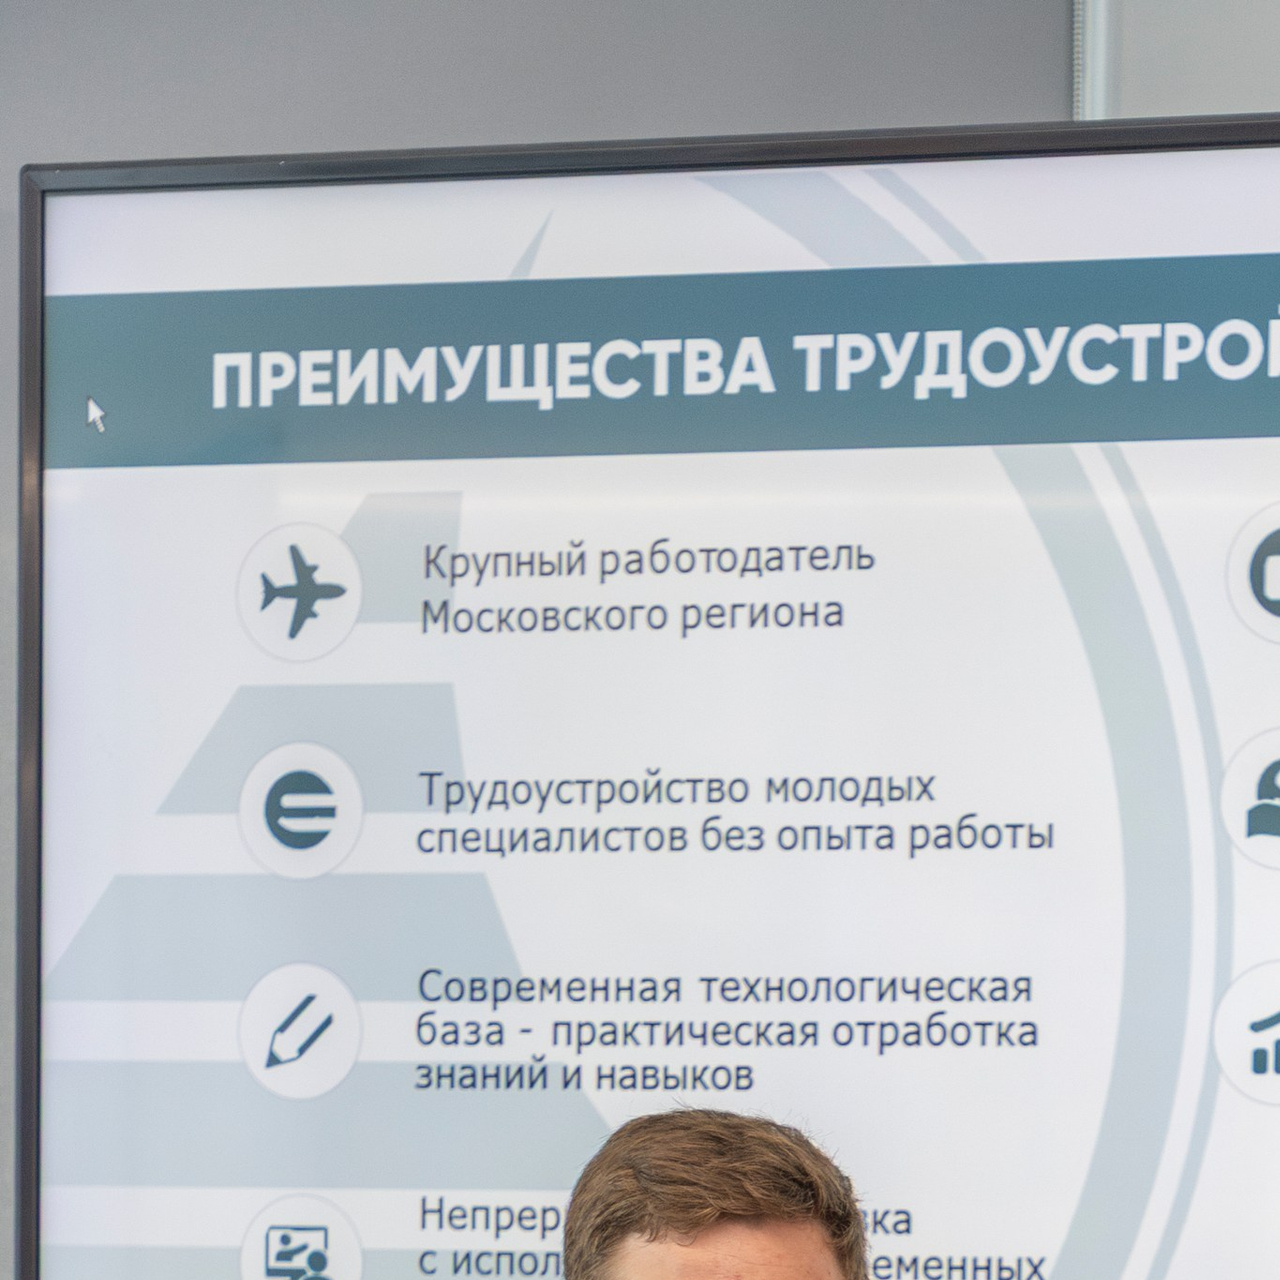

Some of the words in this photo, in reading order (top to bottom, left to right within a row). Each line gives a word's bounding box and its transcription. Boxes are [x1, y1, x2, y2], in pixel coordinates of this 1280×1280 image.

[212, 336, 777, 411] ПРЕИМУЩЕСТВА
[424, 540, 586, 589] Крупный
[599, 537, 876, 585] работодатель
[421, 598, 668, 634] Московского
[681, 601, 844, 639] региона
[417, 767, 750, 815] Трудоустройство
[766, 775, 936, 808] молодых
[416, 826, 688, 858] специалистов
[701, 814, 765, 852] без
[777, 824, 895, 851] опыта
[909, 812, 1054, 859] работы
[417, 967, 681, 1012] Современная
[699, 976, 1032, 1003] технологическая
[416, 1010, 504, 1046] база
[552, 1021, 819, 1055] практическая
[832, 1010, 1038, 1056] отработка
[414, 1054, 548, 1090] знаний
[562, 1065, 582, 1091] и
[596, 1064, 754, 1091] навыков
[420, 1196, 566, 1241] Непрер
[418, 1250, 437, 1276] с
[452, 1249, 561, 1277] испол
